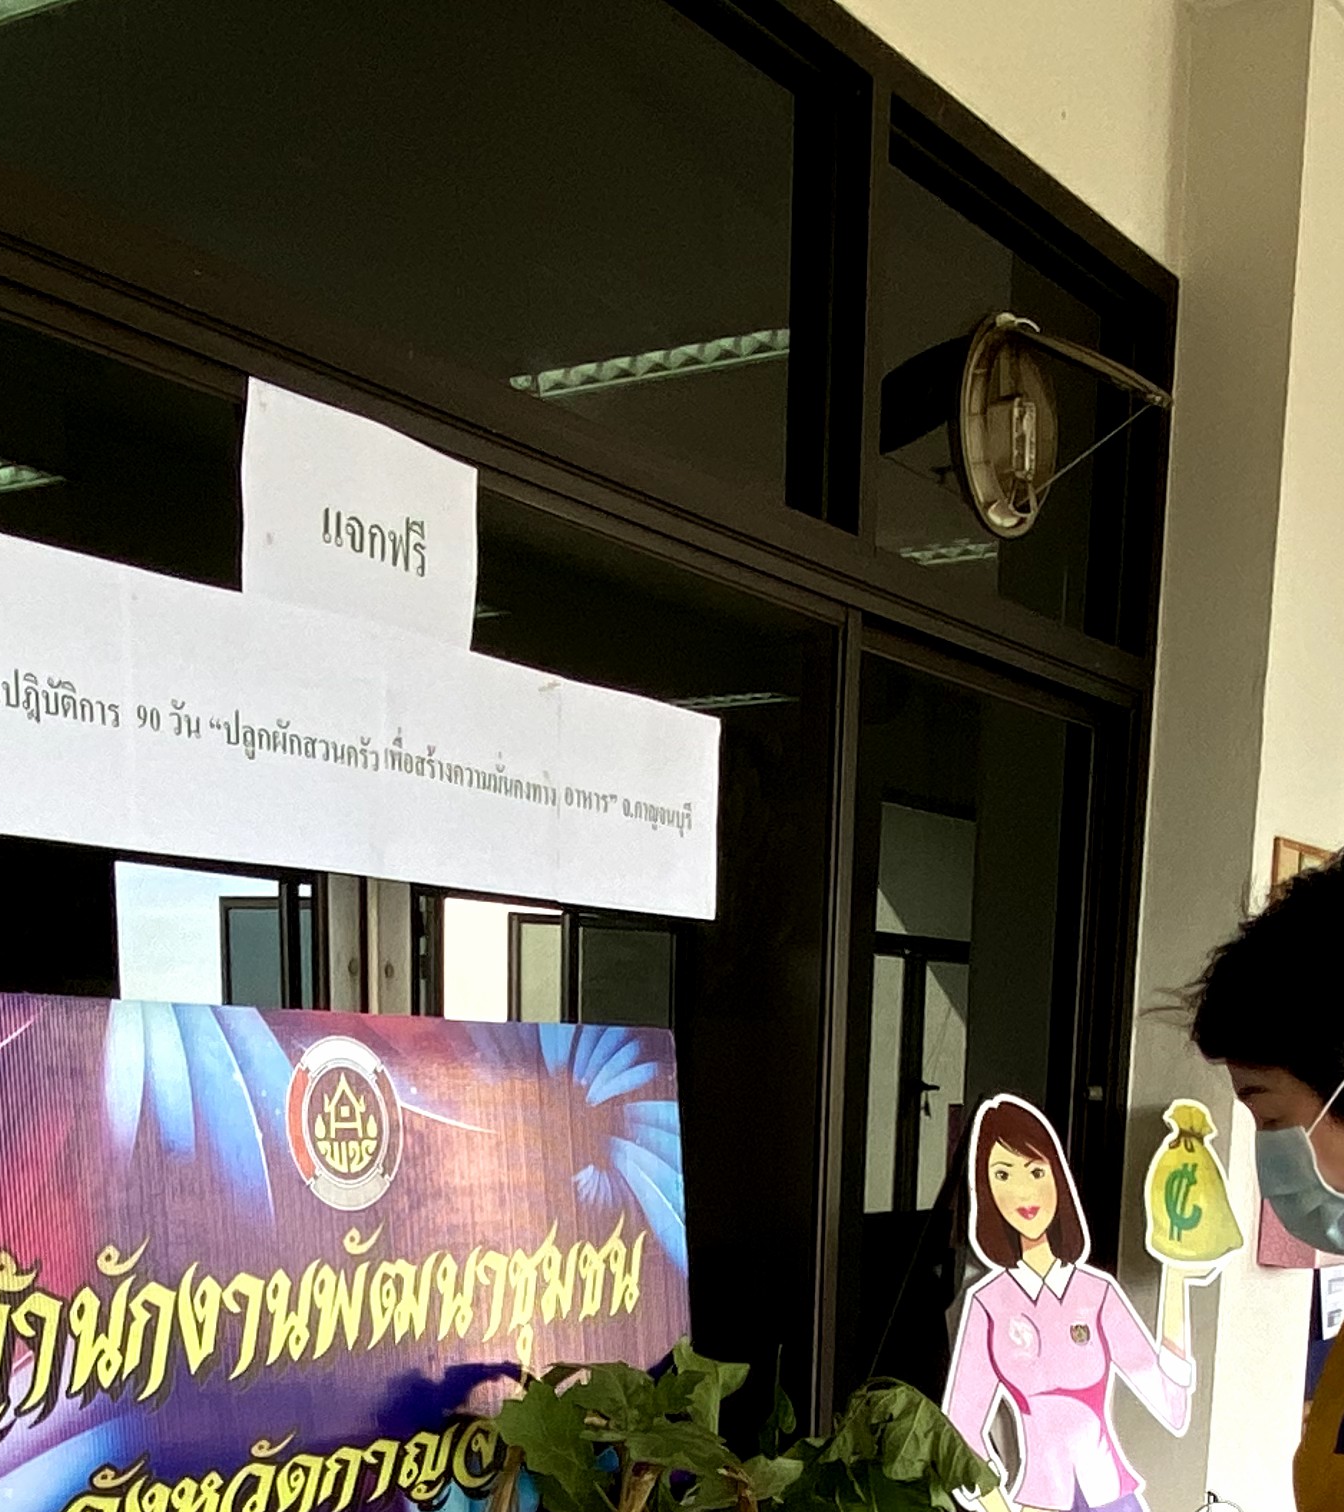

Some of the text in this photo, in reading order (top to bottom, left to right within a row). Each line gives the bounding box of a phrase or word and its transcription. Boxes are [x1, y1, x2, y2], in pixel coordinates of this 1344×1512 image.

[321, 506, 427, 578] แจกฟรี
[136, 704, 161, 732] 90
[167, 698, 203, 740] วัน
